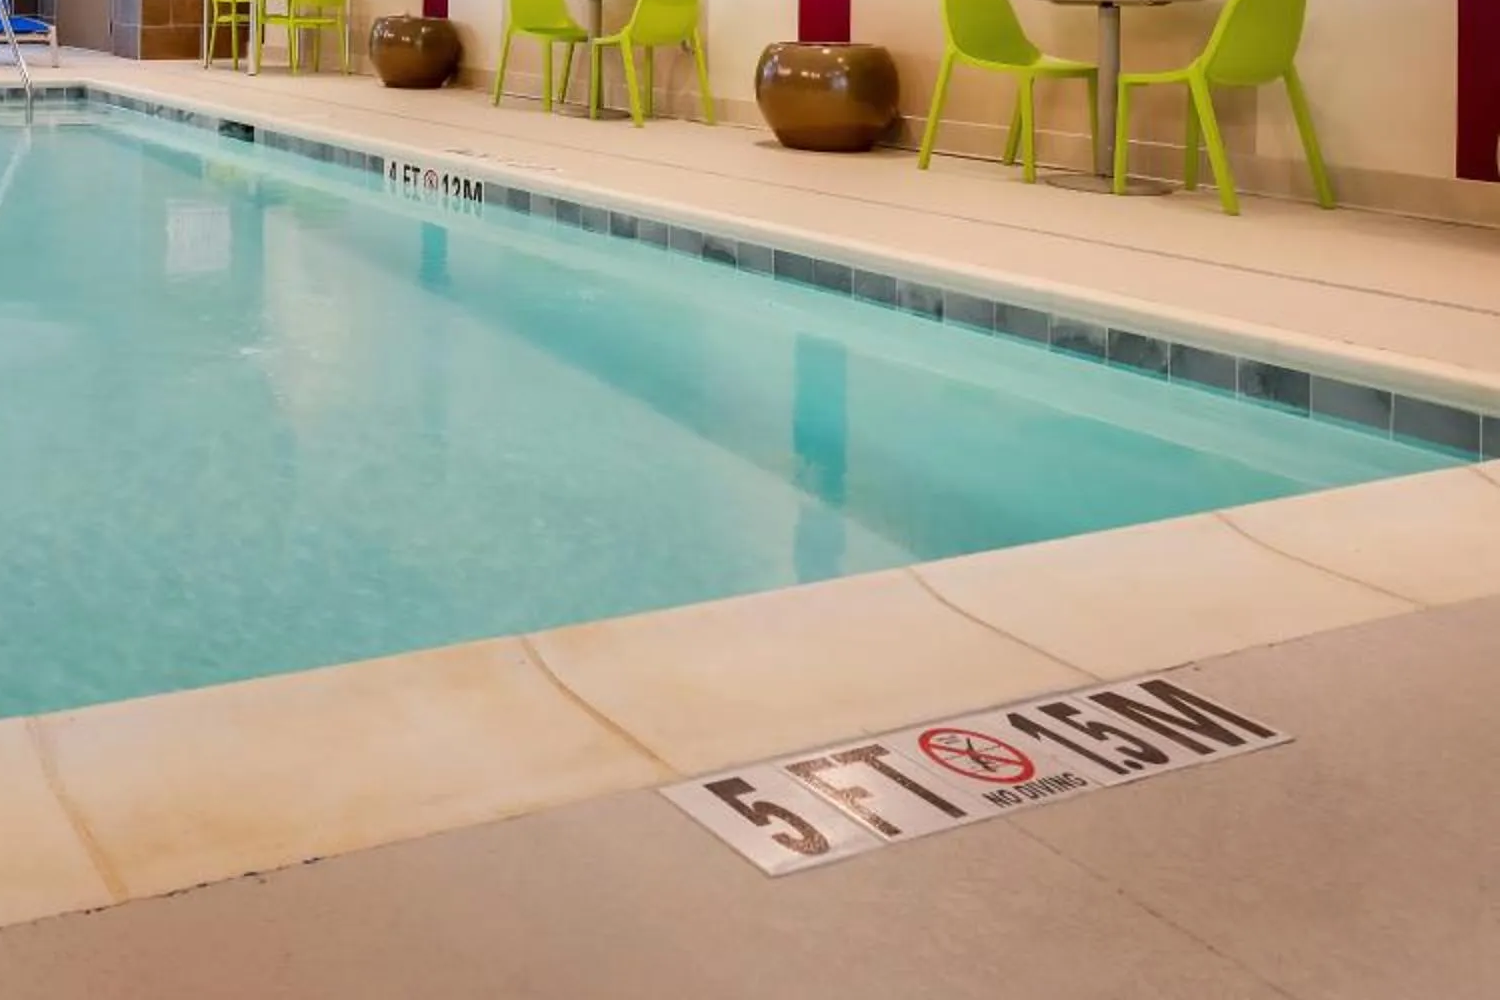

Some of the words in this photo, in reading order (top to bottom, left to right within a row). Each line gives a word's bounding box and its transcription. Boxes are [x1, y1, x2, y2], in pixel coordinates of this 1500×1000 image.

[389, 160, 397, 182] 4
[403, 164, 421, 188] FT
[703, 776, 830, 856] 5
[785, 743, 967, 837] FT
[981, 790, 1023, 809] NO
[1012, 773, 1088, 800] DIVING
